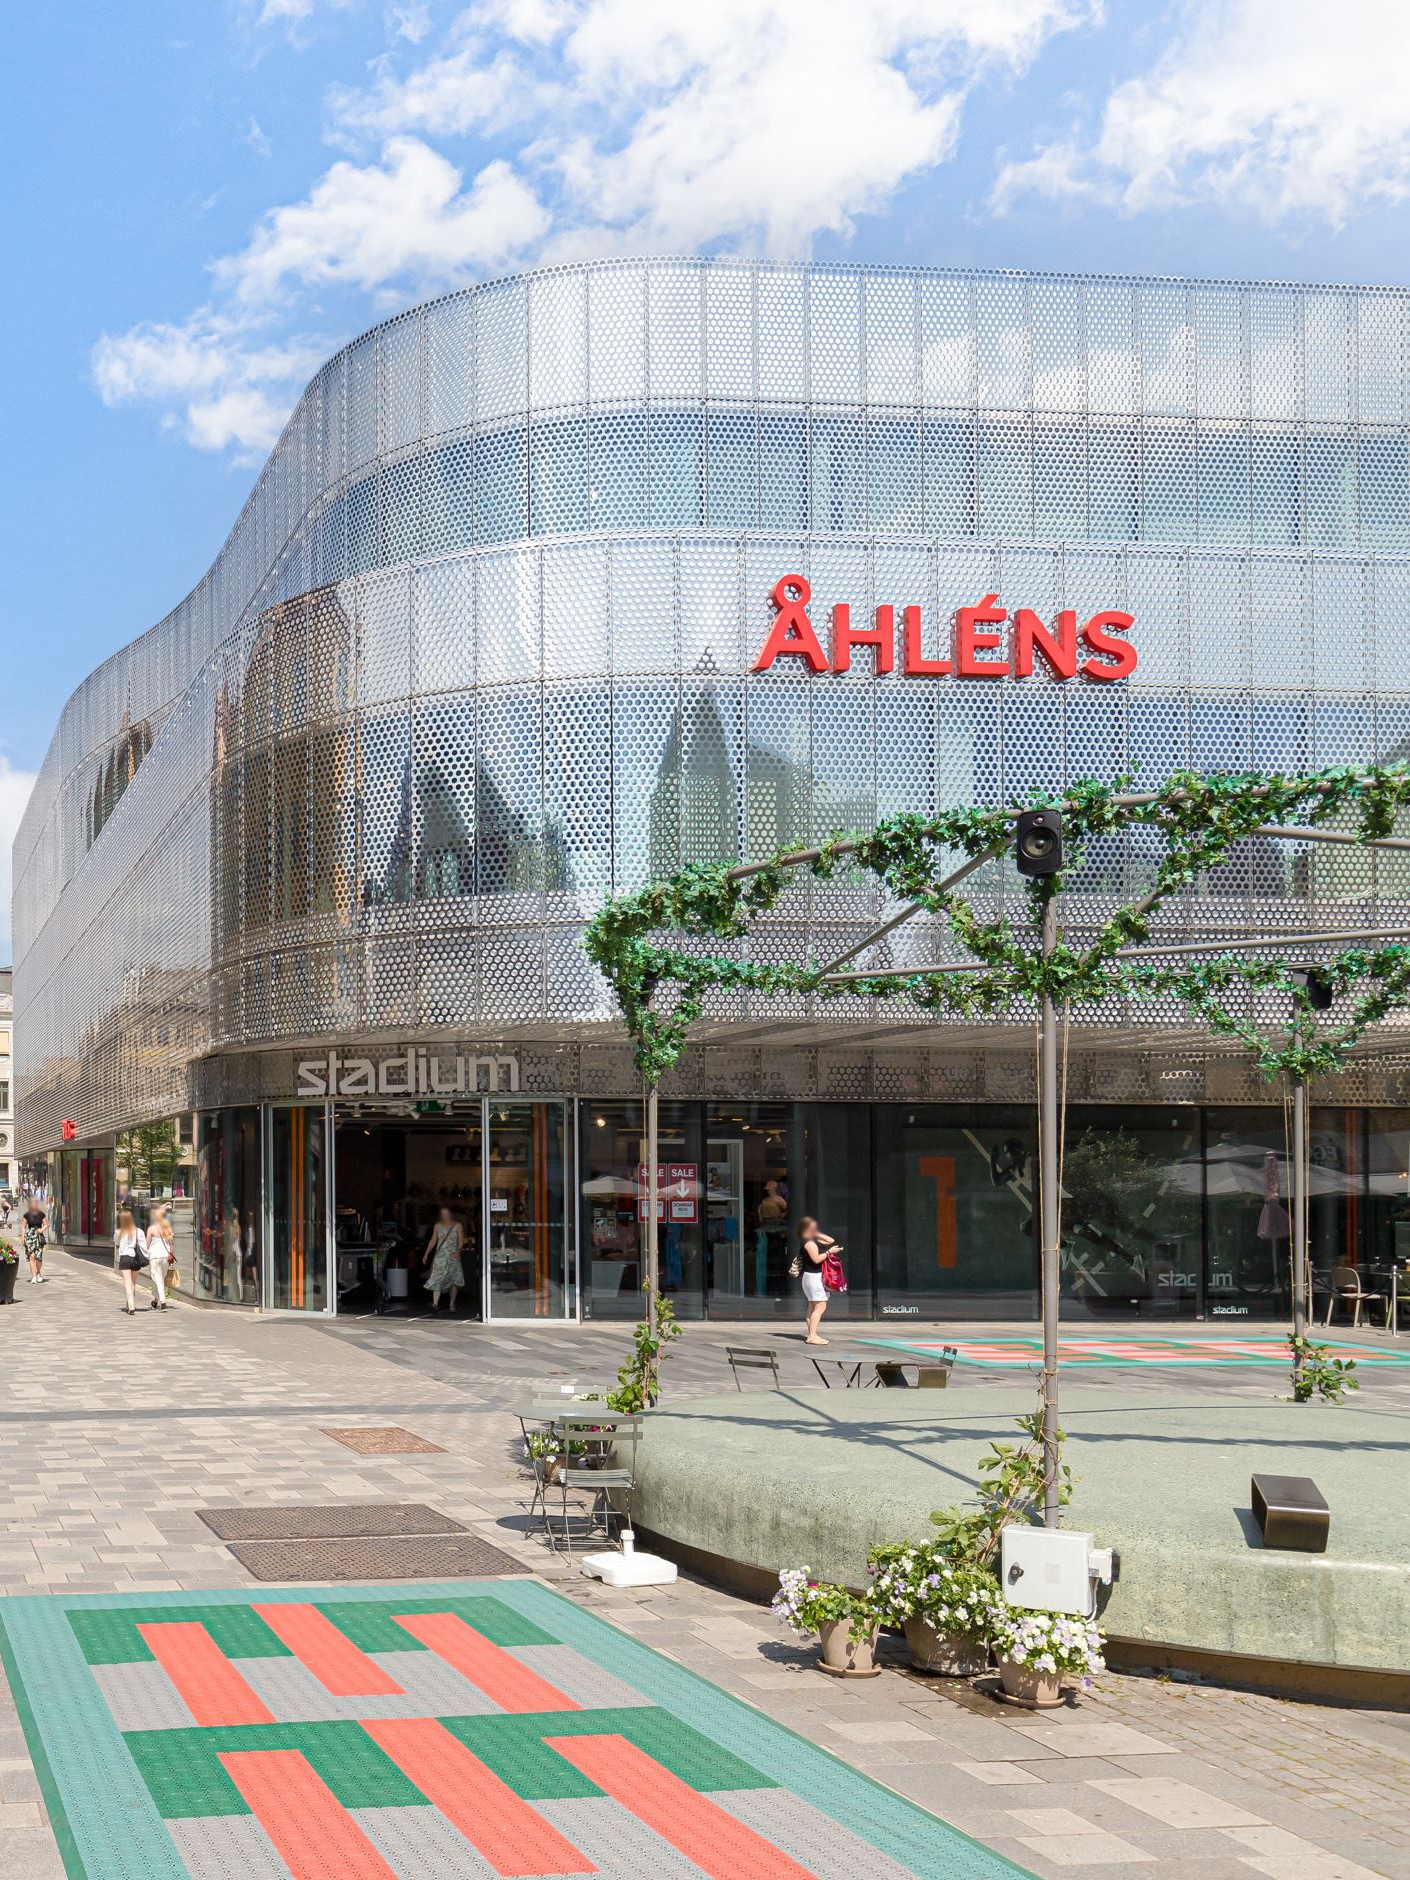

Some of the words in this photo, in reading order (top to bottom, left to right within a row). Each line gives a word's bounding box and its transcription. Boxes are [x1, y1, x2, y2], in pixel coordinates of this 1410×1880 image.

[748, 574, 1138, 681] ÅHLÉNS
[298, 1048, 519, 1096] stadium
[671, 1168, 694, 1177] SALE
[883, 1305, 919, 1314] stadium
[1212, 1305, 1248, 1314] stadium
